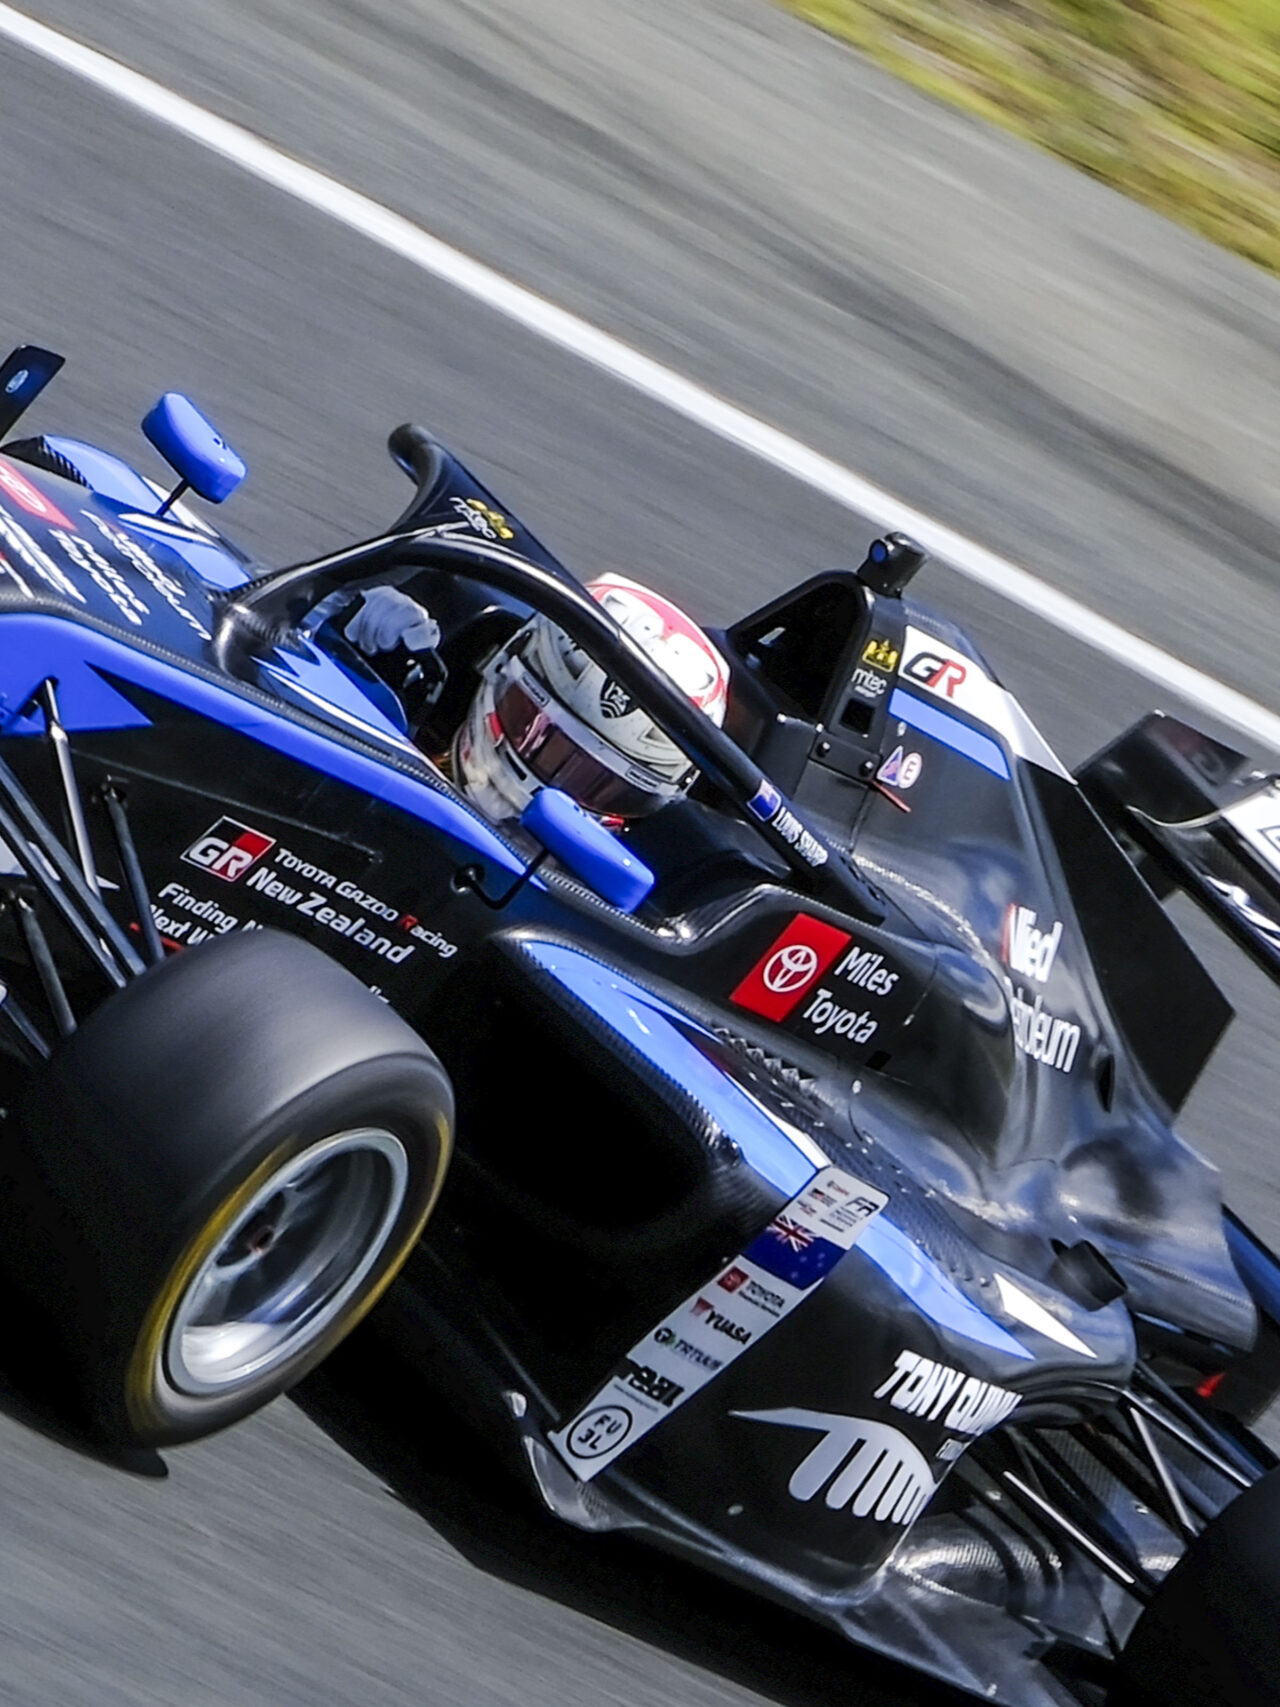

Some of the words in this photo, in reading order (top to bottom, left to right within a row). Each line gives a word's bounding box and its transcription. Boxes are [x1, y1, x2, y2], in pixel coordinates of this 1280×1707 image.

[851, 667, 888, 697] mtec
[904, 651, 968, 700] GR
[188, 836, 254, 879] GR
[158, 881, 239, 934] Finding
[246, 867, 304, 907] New
[297, 891, 415, 966] Zealand
[274, 847, 338, 889] TOYOTA
[335, 880, 400, 923] GAZOO
[399, 914, 459, 960] Racing
[834, 945, 900, 997] Miles
[802, 988, 880, 1045] Toyota
[703, 1309, 754, 1346] YUASA
[873, 1349, 963, 1422] TONY
[593, 1413, 624, 1435] FU
